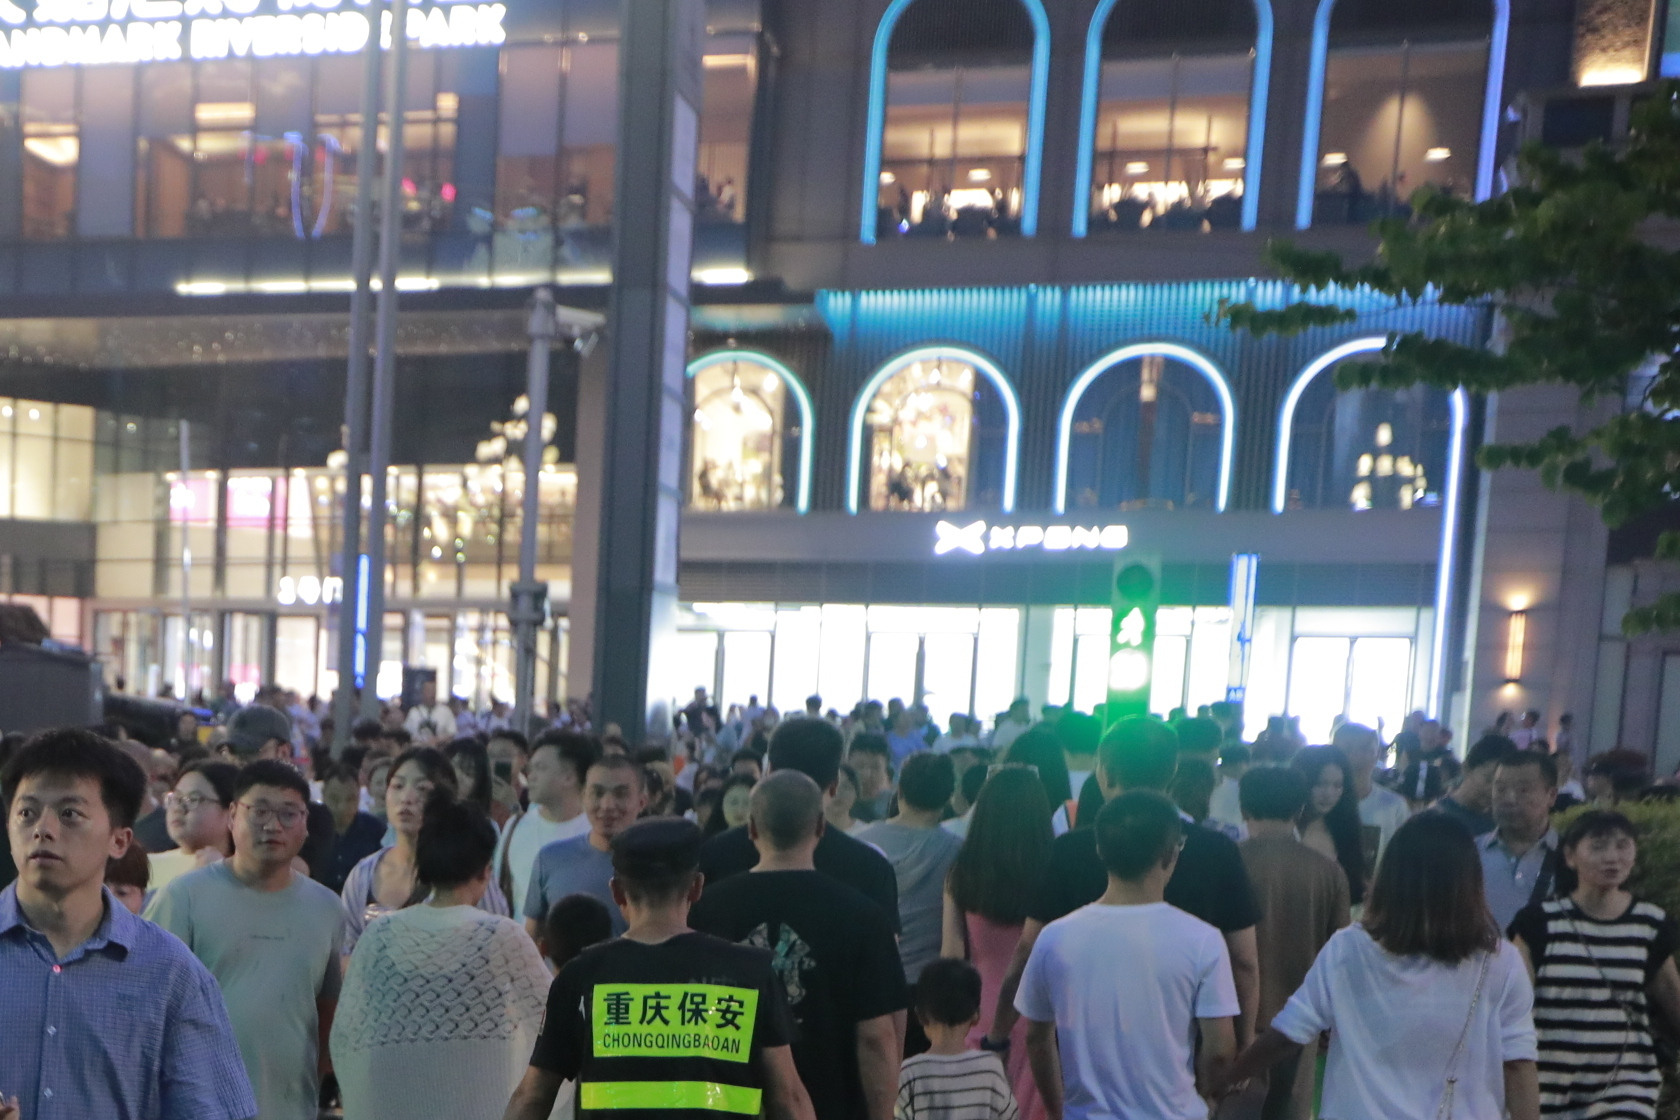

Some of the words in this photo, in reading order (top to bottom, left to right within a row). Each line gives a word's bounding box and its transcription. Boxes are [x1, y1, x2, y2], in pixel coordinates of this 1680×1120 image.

[602, 990, 745, 1032] 重庆保安
[602, 1032, 742, 1055] CHONGQINGBAOAN
